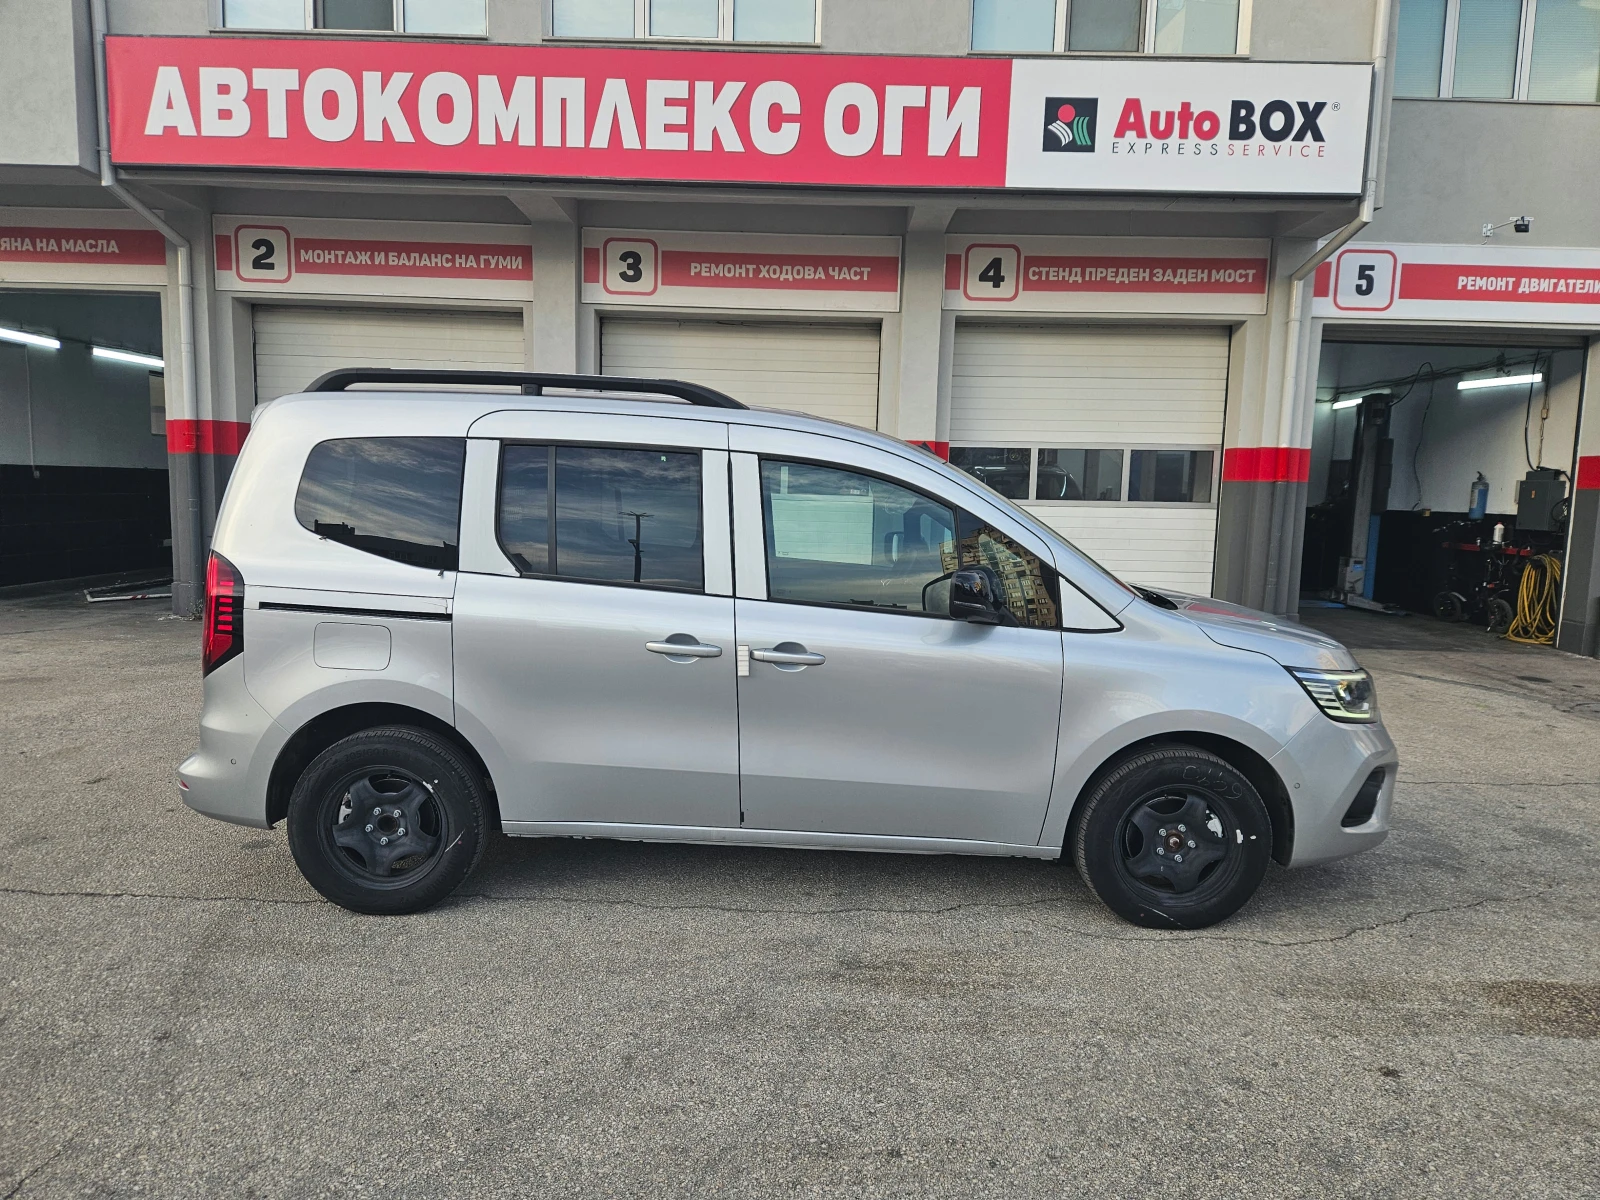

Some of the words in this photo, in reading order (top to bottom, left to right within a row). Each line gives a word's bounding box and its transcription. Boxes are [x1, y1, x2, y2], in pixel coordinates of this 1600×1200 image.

[144, 66, 801, 156] АВТОКОМПЛЕКС
[824, 82, 982, 158] ОГИ
[1113, 98, 1221, 141] Auto
[1228, 99, 1328, 142] BOX
[1112, 142, 1218, 156] EXPRESS
[1227, 144, 1326, 158] SERVICE
[36, 238, 59, 252] НА
[61, 239, 120, 254] МАСЛА
[251, 238, 275, 271] 2
[299, 248, 371, 267] МОНТАЖ
[374, 251, 385, 265] И
[388, 252, 452, 268] БАЛАНС
[455, 253, 477, 268] НА
[480, 254, 523, 270] ГУМИ
[618, 250, 643, 283] 3
[690, 262, 756, 280] РЕМОНТ
[759, 264, 826, 282] ХОДОВА
[829, 266, 872, 281] ЧАСТ
[978, 257, 1006, 289] 4
[1028, 266, 1083, 283] СТЕНД
[1085, 267, 1150, 284] ПРЕДЕН
[1153, 268, 1208, 285] ЗАДЕН
[1211, 269, 1256, 283] МОСТ
[1355, 264, 1376, 296] 5
[1457, 275, 1516, 291] РЕМОНТ
